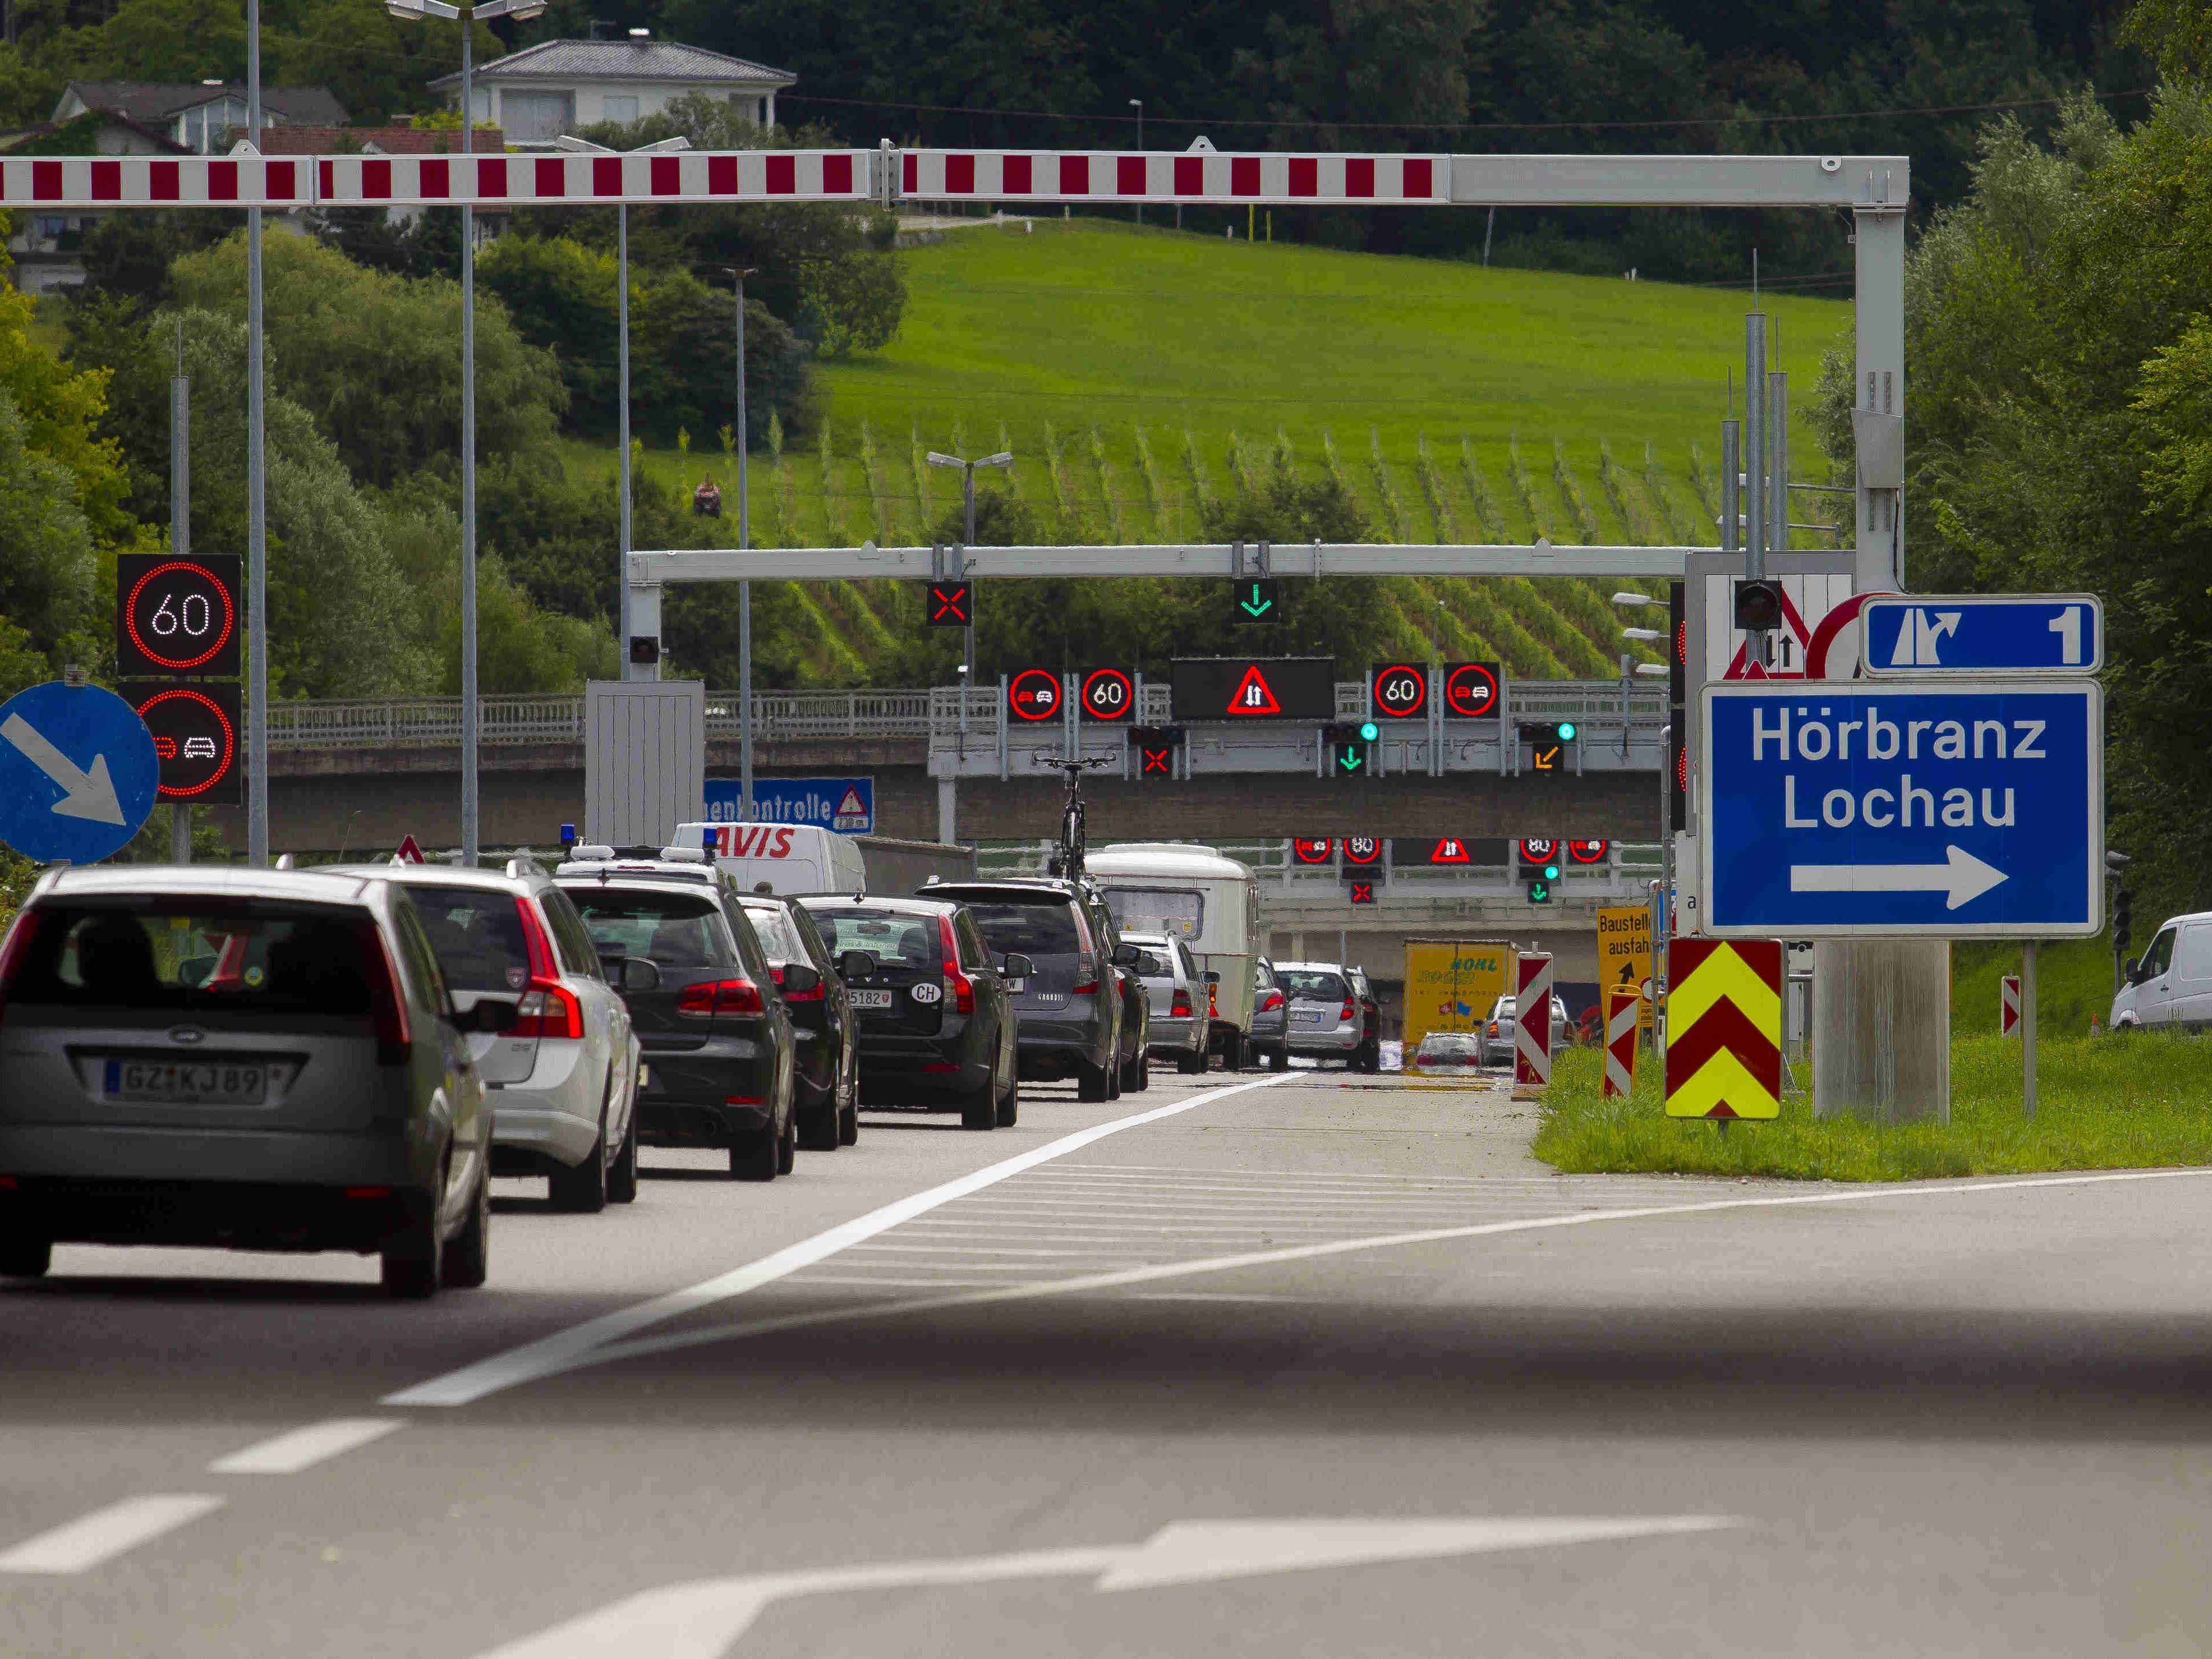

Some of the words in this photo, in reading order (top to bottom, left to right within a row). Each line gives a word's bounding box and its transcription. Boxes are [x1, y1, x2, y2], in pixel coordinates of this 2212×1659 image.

[152, 593, 209, 635] 60
[2049, 607, 2081, 664] 1
[1094, 683, 1121, 704] 60
[1386, 680, 1414, 701] 60
[1753, 707, 2046, 761] Hörbranz
[1785, 775, 2015, 828] Lochau
[716, 827, 795, 859] AVIS
[1609, 937, 1650, 955] ausfah
[917, 986, 935, 1001] CH
